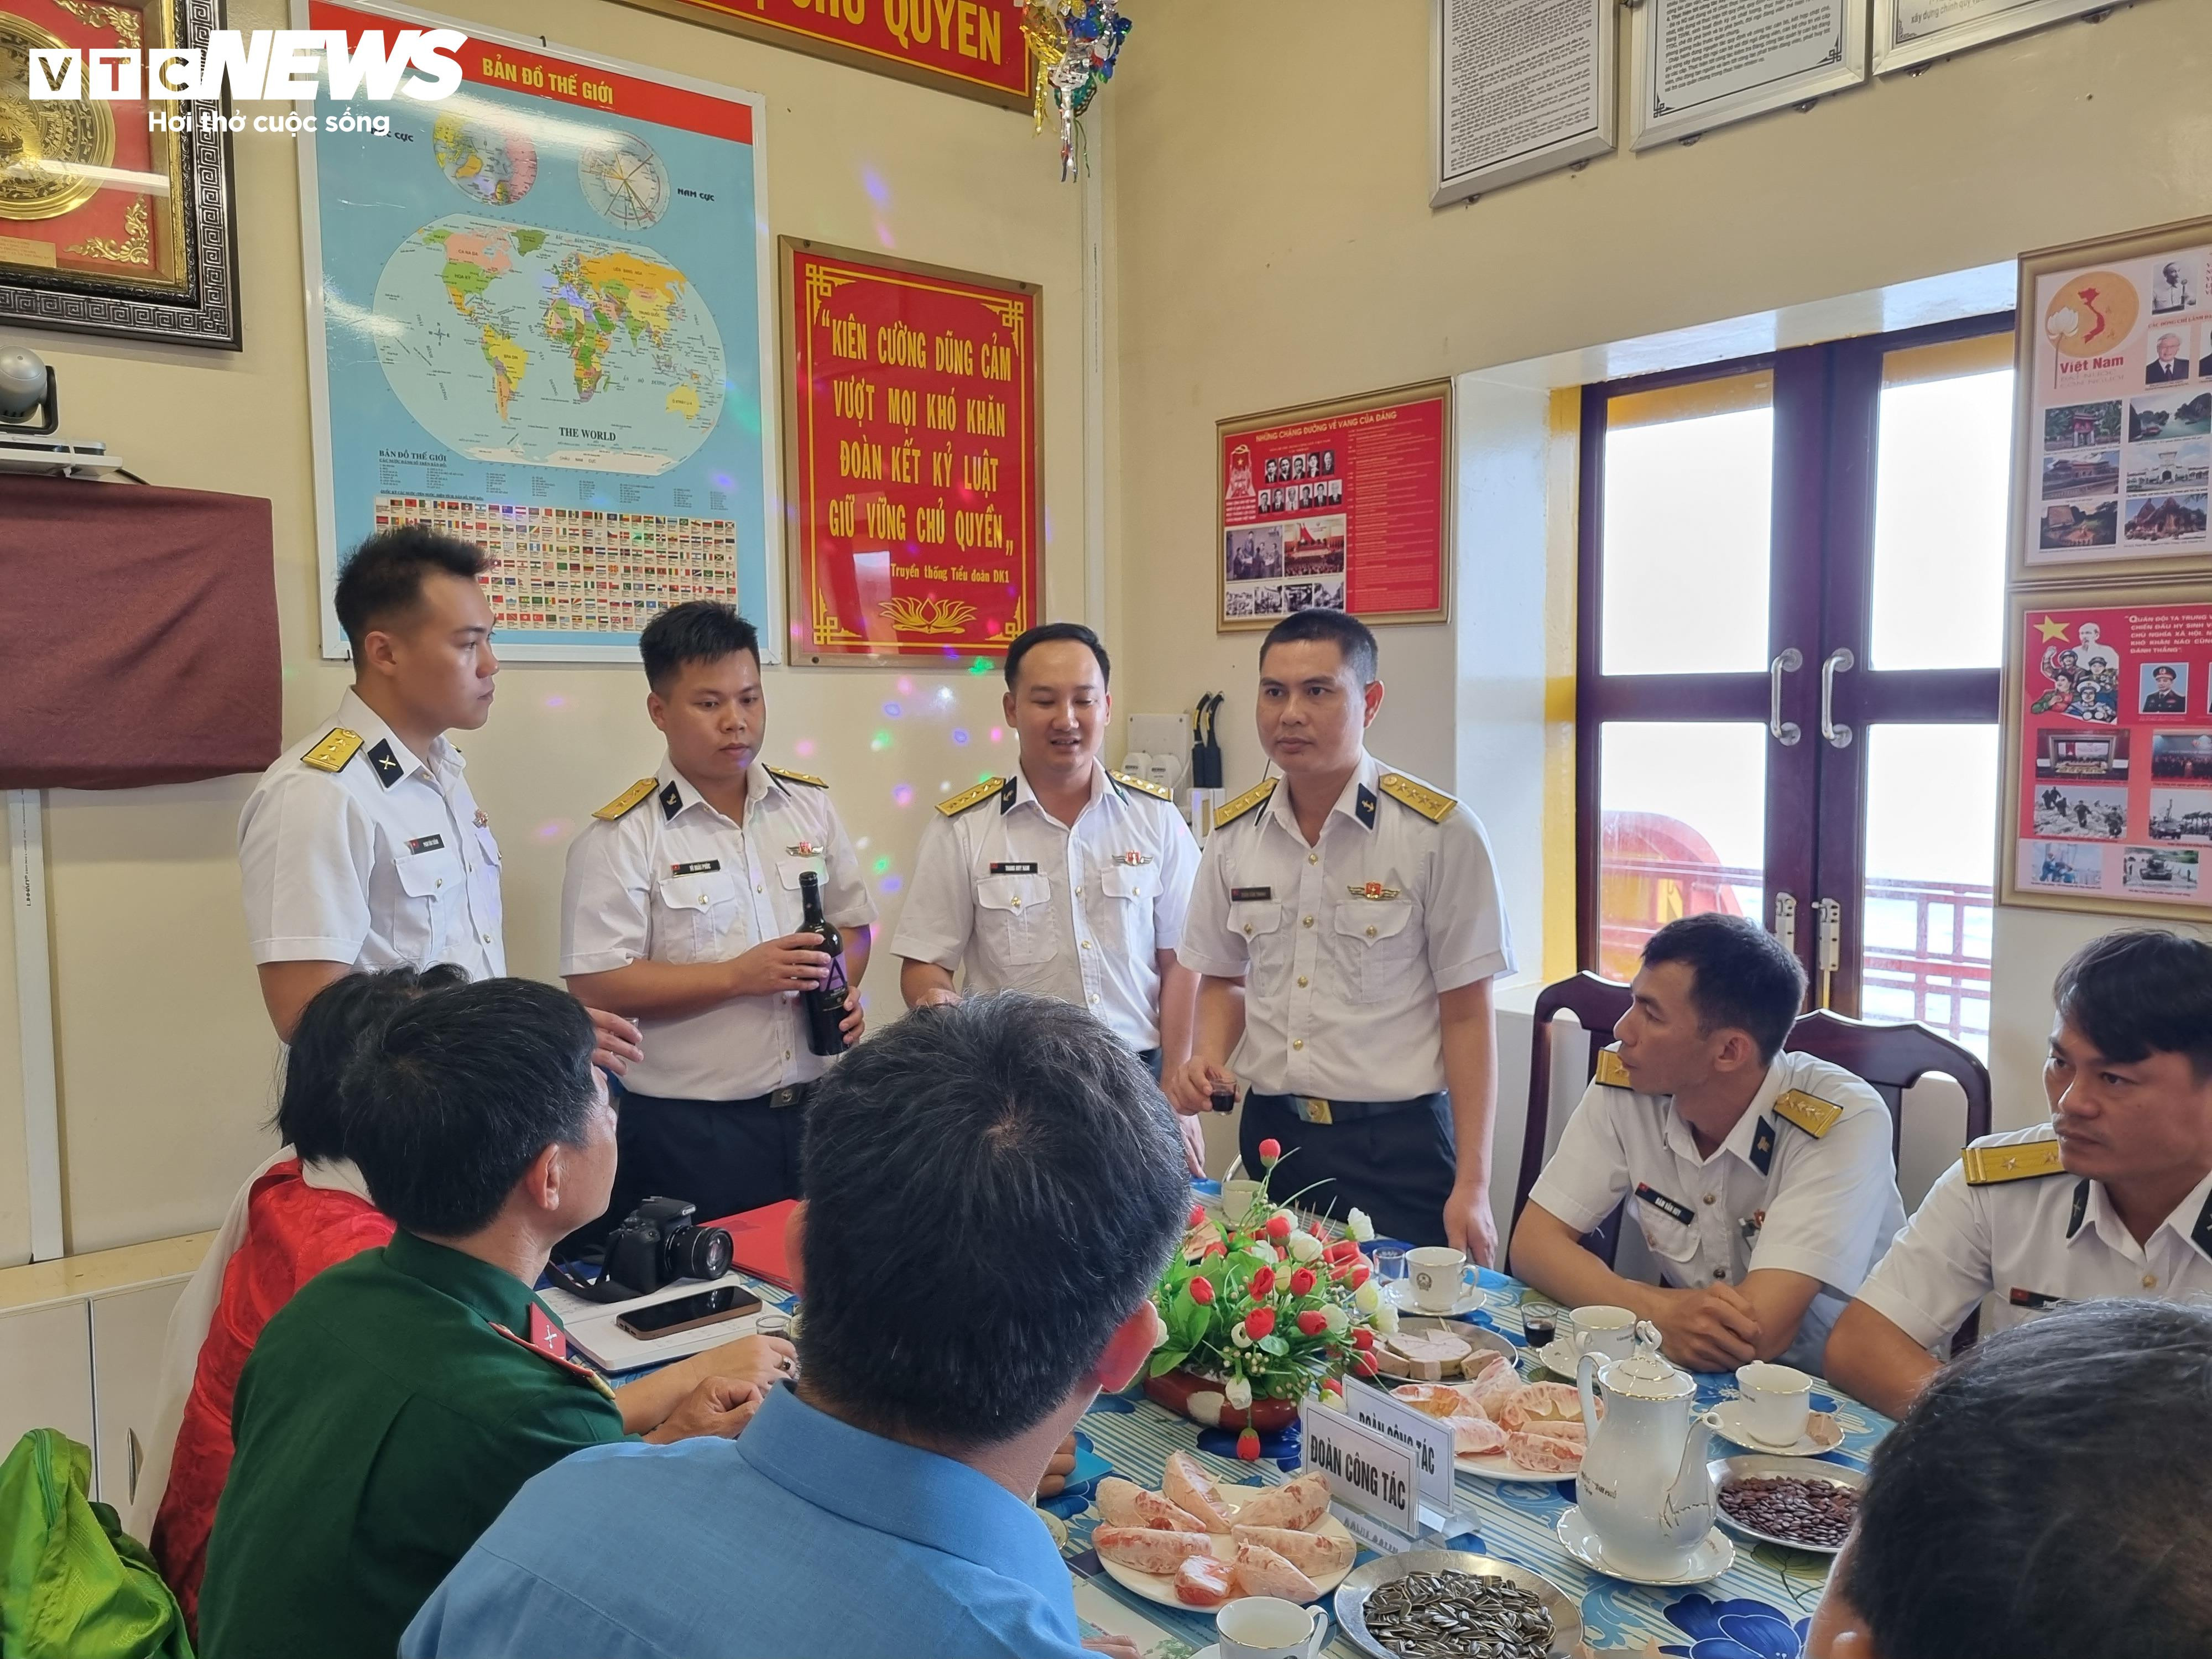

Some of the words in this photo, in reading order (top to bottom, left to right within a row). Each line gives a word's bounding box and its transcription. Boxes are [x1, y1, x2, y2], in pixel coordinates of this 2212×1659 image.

[483, 54, 518, 82] BẢN
[522, 65, 544, 88] ĐỒ
[548, 73, 578, 97] THẾ
[582, 81, 613, 105] GIỚI
[677, 188, 697, 198] NAM
[877, 320, 926, 369] CƯỜNG
[936, 330, 973, 377] DŨNG
[981, 332, 1011, 382] CẢM
[2060, 359, 2089, 374] Việt
[2093, 356, 2124, 369] Nam
[833, 375, 875, 427] VƯỢT
[888, 388, 916, 434] MỌI
[927, 387, 957, 431] KHÓ
[967, 394, 1005, 437] KHĂN
[1338, 418, 1358, 429] VANG
[1359, 414, 1374, 424] CỦA
[559, 426, 579, 437] THE
[581, 429, 617, 441] WORLD
[379, 448, 397, 457] BẢN
[398, 448, 410, 458] ĐỒ
[411, 451, 427, 461] THẾ
[429, 453, 447, 462] GIỚI
[840, 435, 882, 481] ĐOÀN
[891, 438, 921, 484] KẾT
[933, 441, 953, 488] KỶ
[964, 449, 999, 498] LUẬT
[830, 494, 856, 538] GIỮ
[866, 497, 906, 540] VỮNG
[916, 497, 946, 544] CHỦ
[891, 563, 920, 578] Truyền
[924, 563, 948, 582] thống
[951, 565, 968, 582] Tiểu
[971, 568, 990, 582] đoàn
[993, 570, 1010, 583] DK1
[1311, 1434, 1342, 1477] ĐOÀN
[1345, 1452, 1378, 1496] CÔNG
[1382, 1470, 1406, 1510] TÁC
